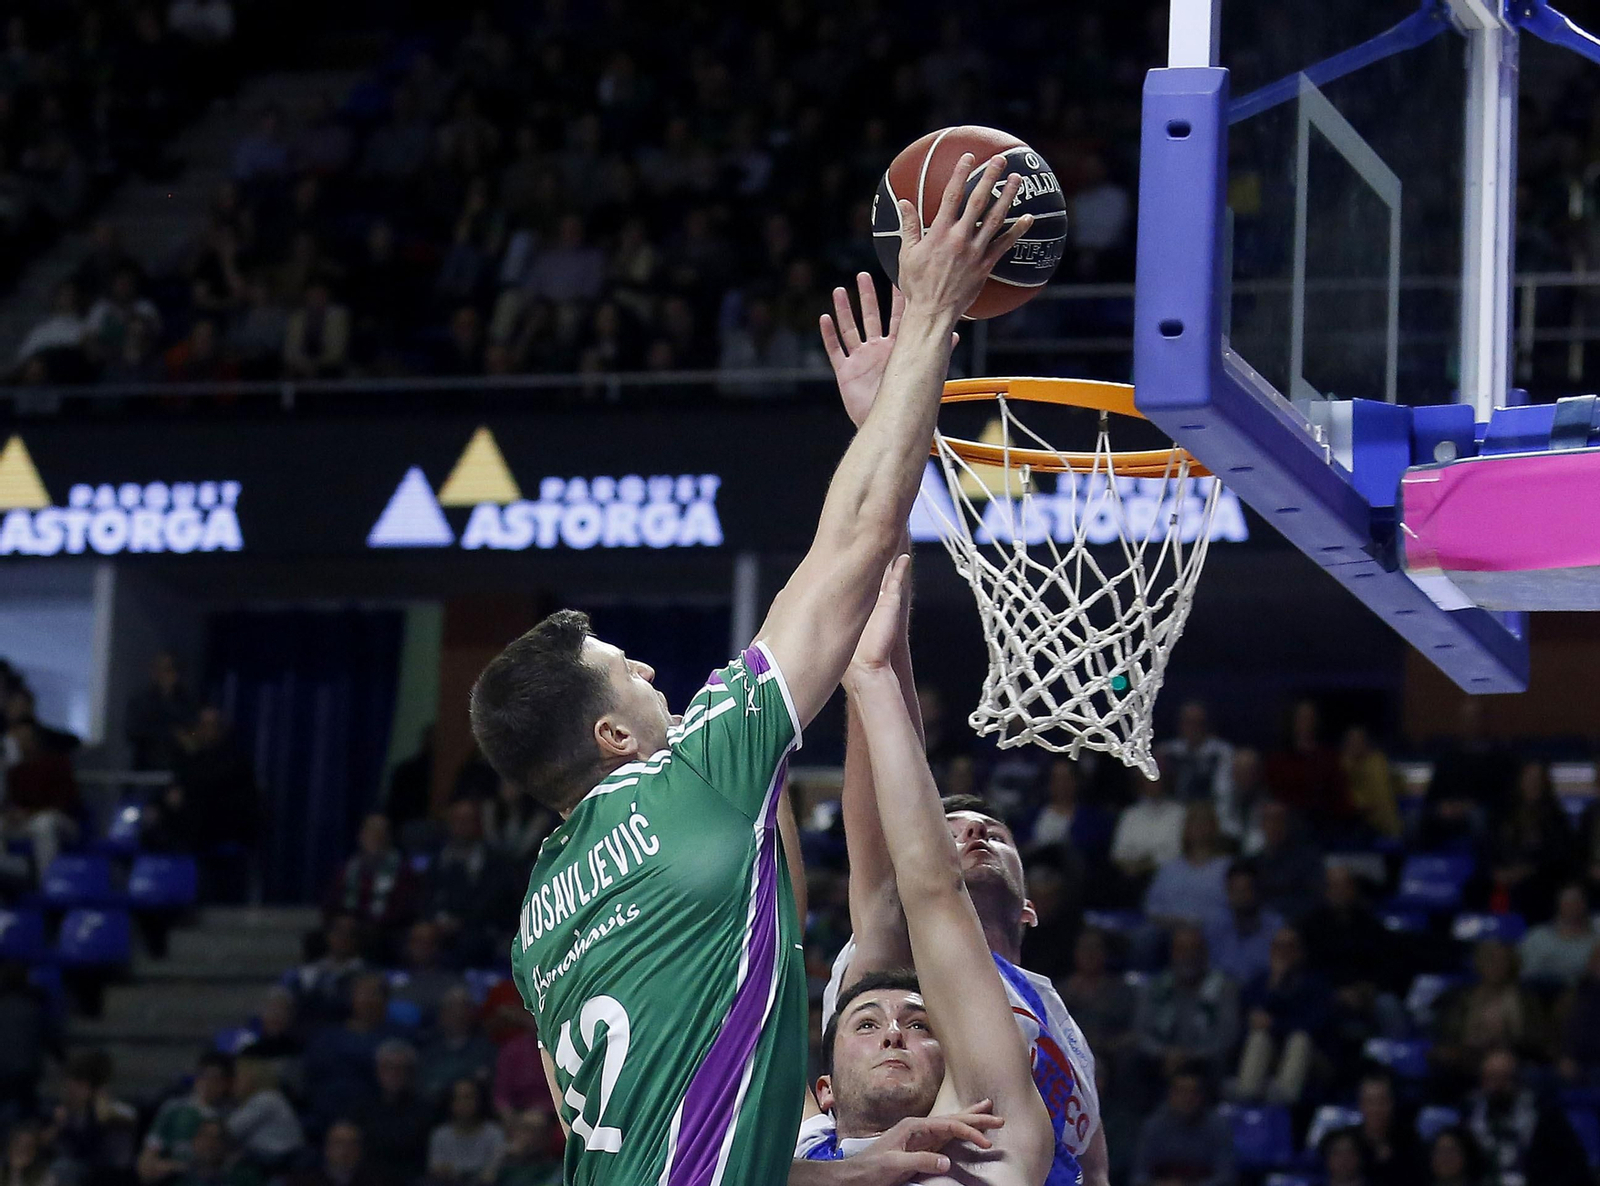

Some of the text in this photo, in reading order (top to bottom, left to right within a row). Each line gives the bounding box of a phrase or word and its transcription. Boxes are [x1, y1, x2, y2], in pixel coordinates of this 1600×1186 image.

[0, 505, 244, 555] ASTORGA
[461, 500, 724, 549] ASTORGA
[556, 994, 631, 1153] 12
